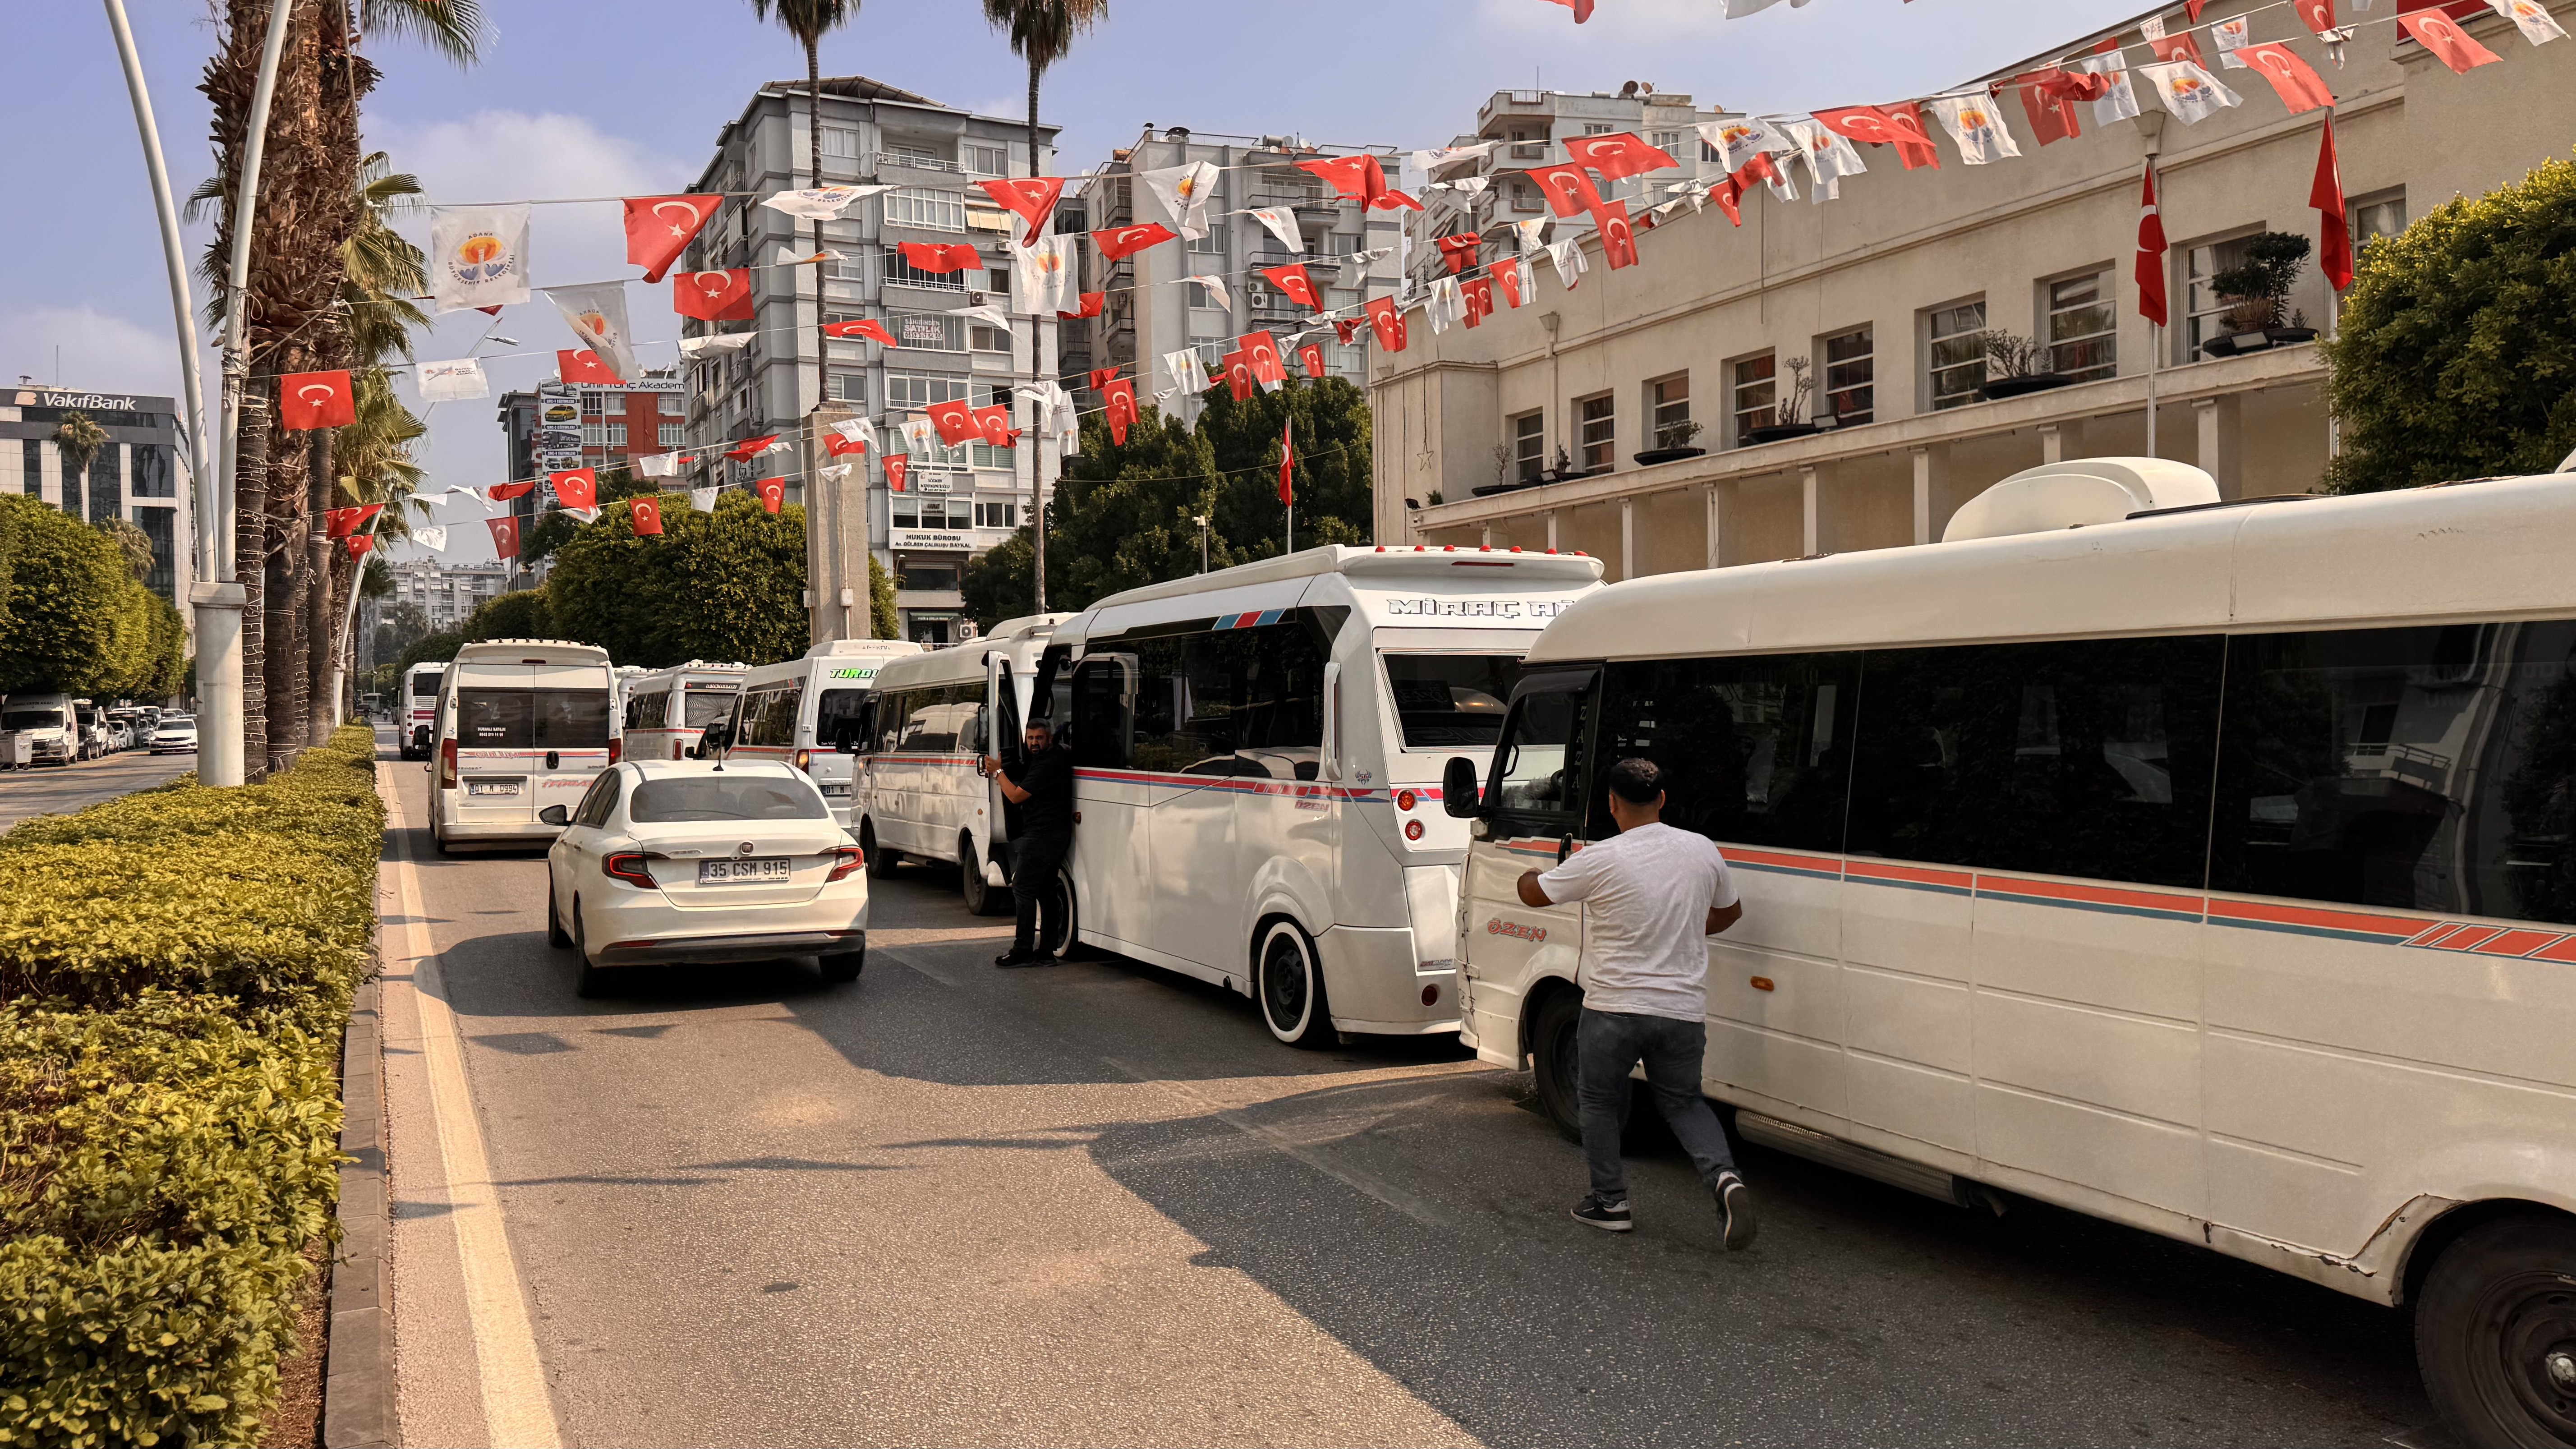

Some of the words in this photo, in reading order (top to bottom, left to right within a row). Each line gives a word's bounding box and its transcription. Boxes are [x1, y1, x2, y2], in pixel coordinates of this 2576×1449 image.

[904, 324, 941, 334] SATILIK
[43, 392, 136, 411] VakıfBank
[1386, 598, 1521, 619] MİRAÇ
[710, 863, 727, 877] 35
[733, 862, 757, 876] CSM
[763, 861, 787, 875] 915
[1487, 917, 1547, 942] ÖZEN
